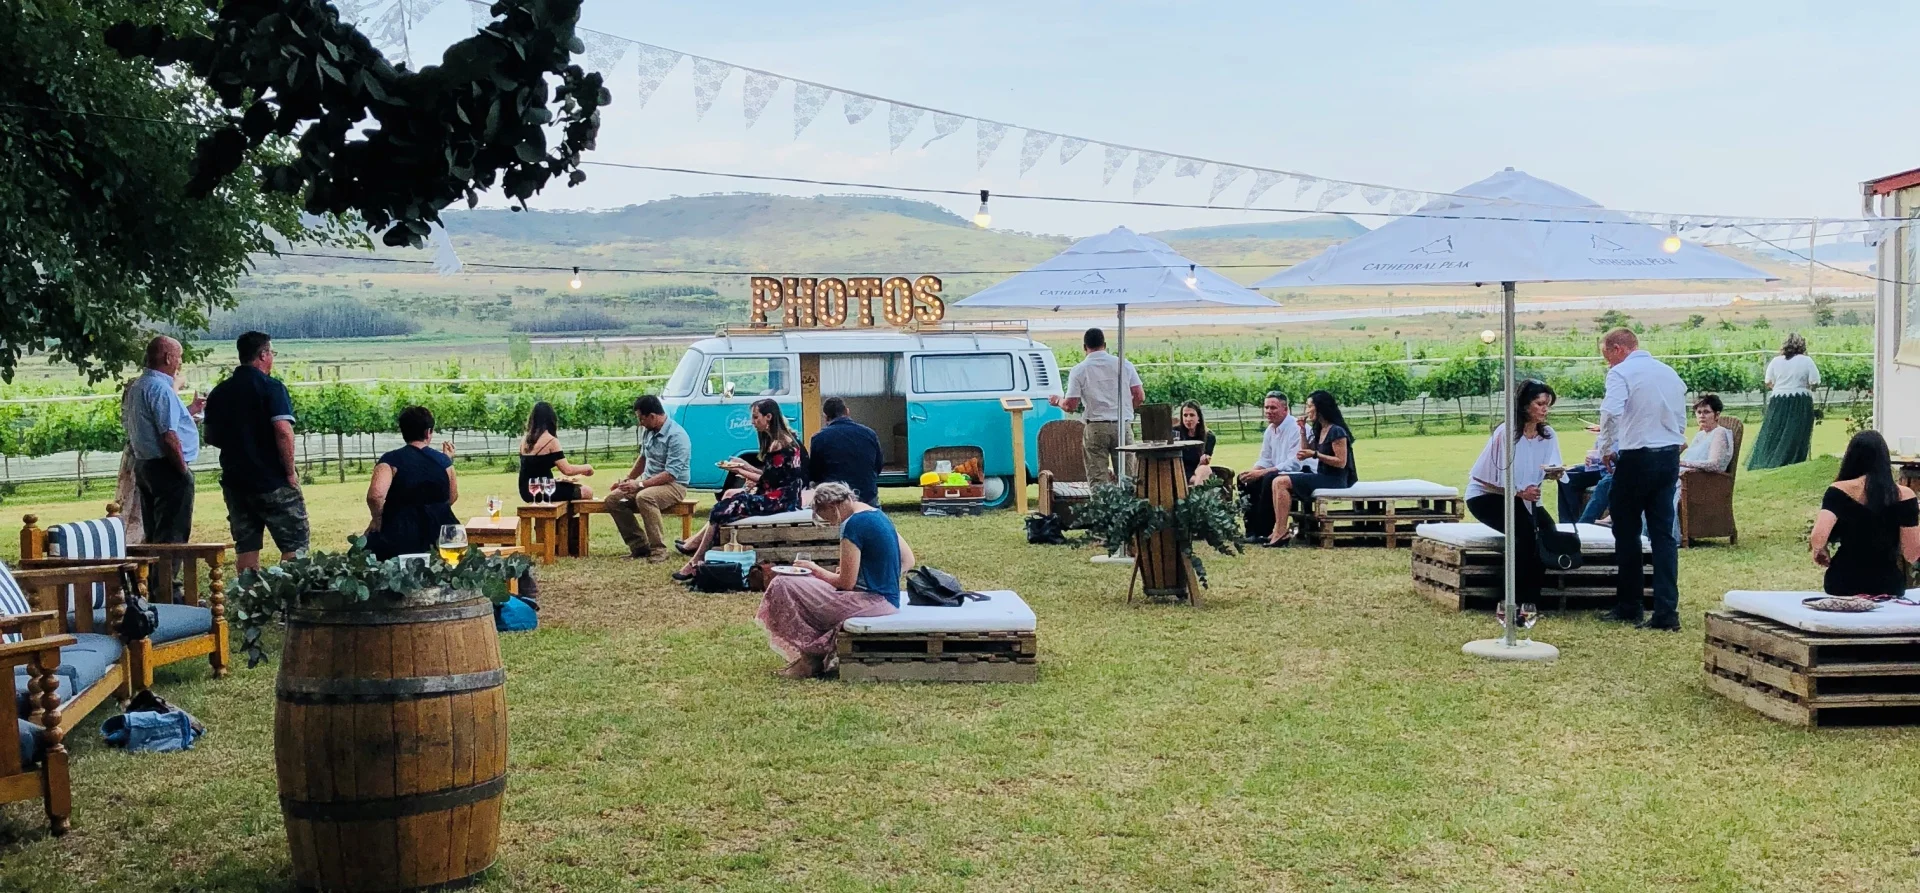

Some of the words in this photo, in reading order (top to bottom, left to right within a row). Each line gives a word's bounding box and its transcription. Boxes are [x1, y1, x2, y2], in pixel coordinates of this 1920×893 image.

[1362, 262, 1437, 271] CATHEDRAL
[1440, 260, 1474, 269] PEAK
[750, 275, 945, 327] PHOTOS
